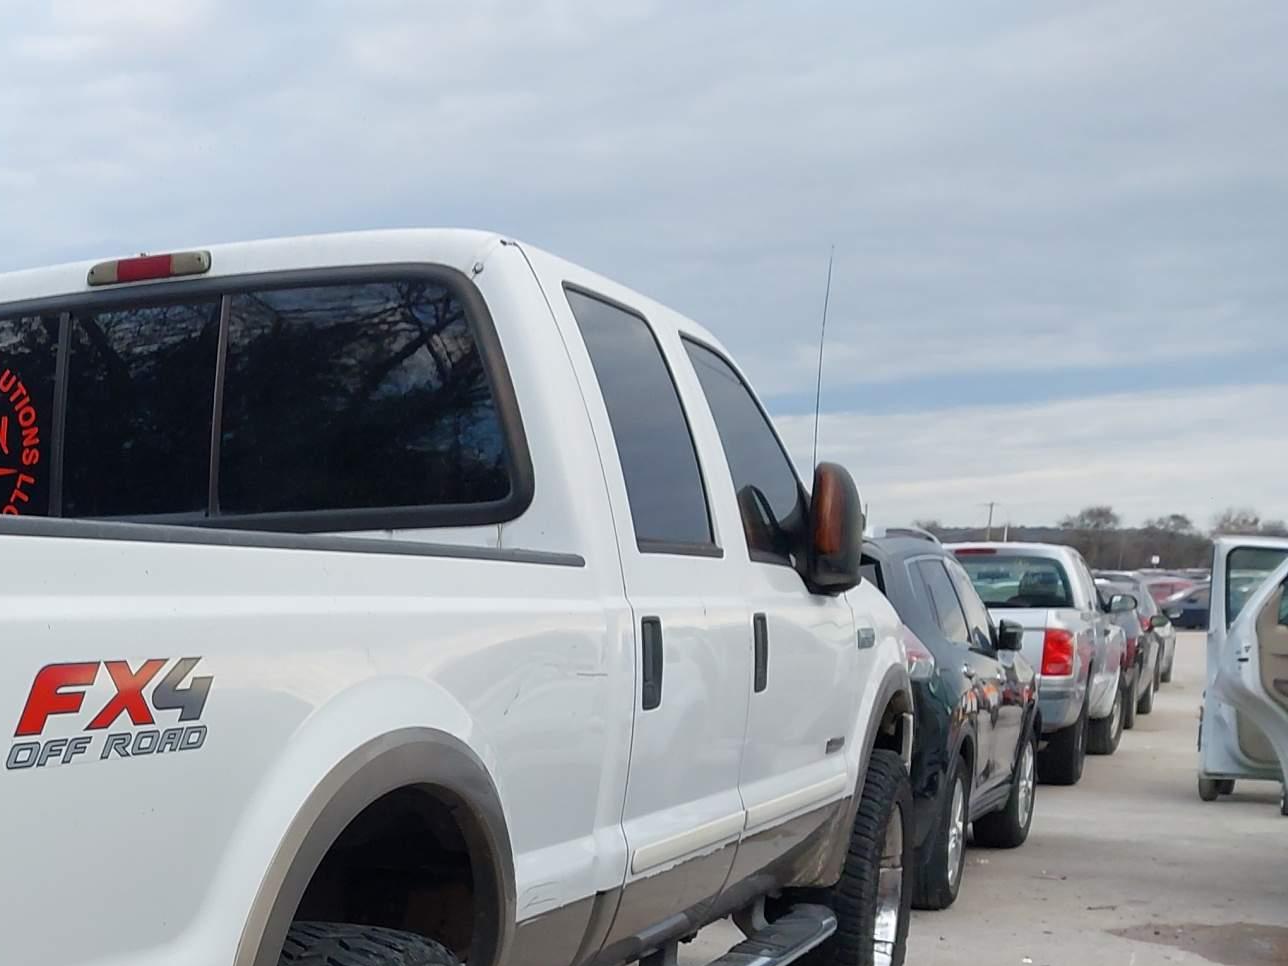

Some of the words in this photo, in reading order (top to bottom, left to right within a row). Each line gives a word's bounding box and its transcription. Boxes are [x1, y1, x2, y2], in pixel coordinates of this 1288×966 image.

[13, 655, 215, 737] FX4
[5, 735, 93, 770] OFF
[99, 724, 208, 760] ROAD
